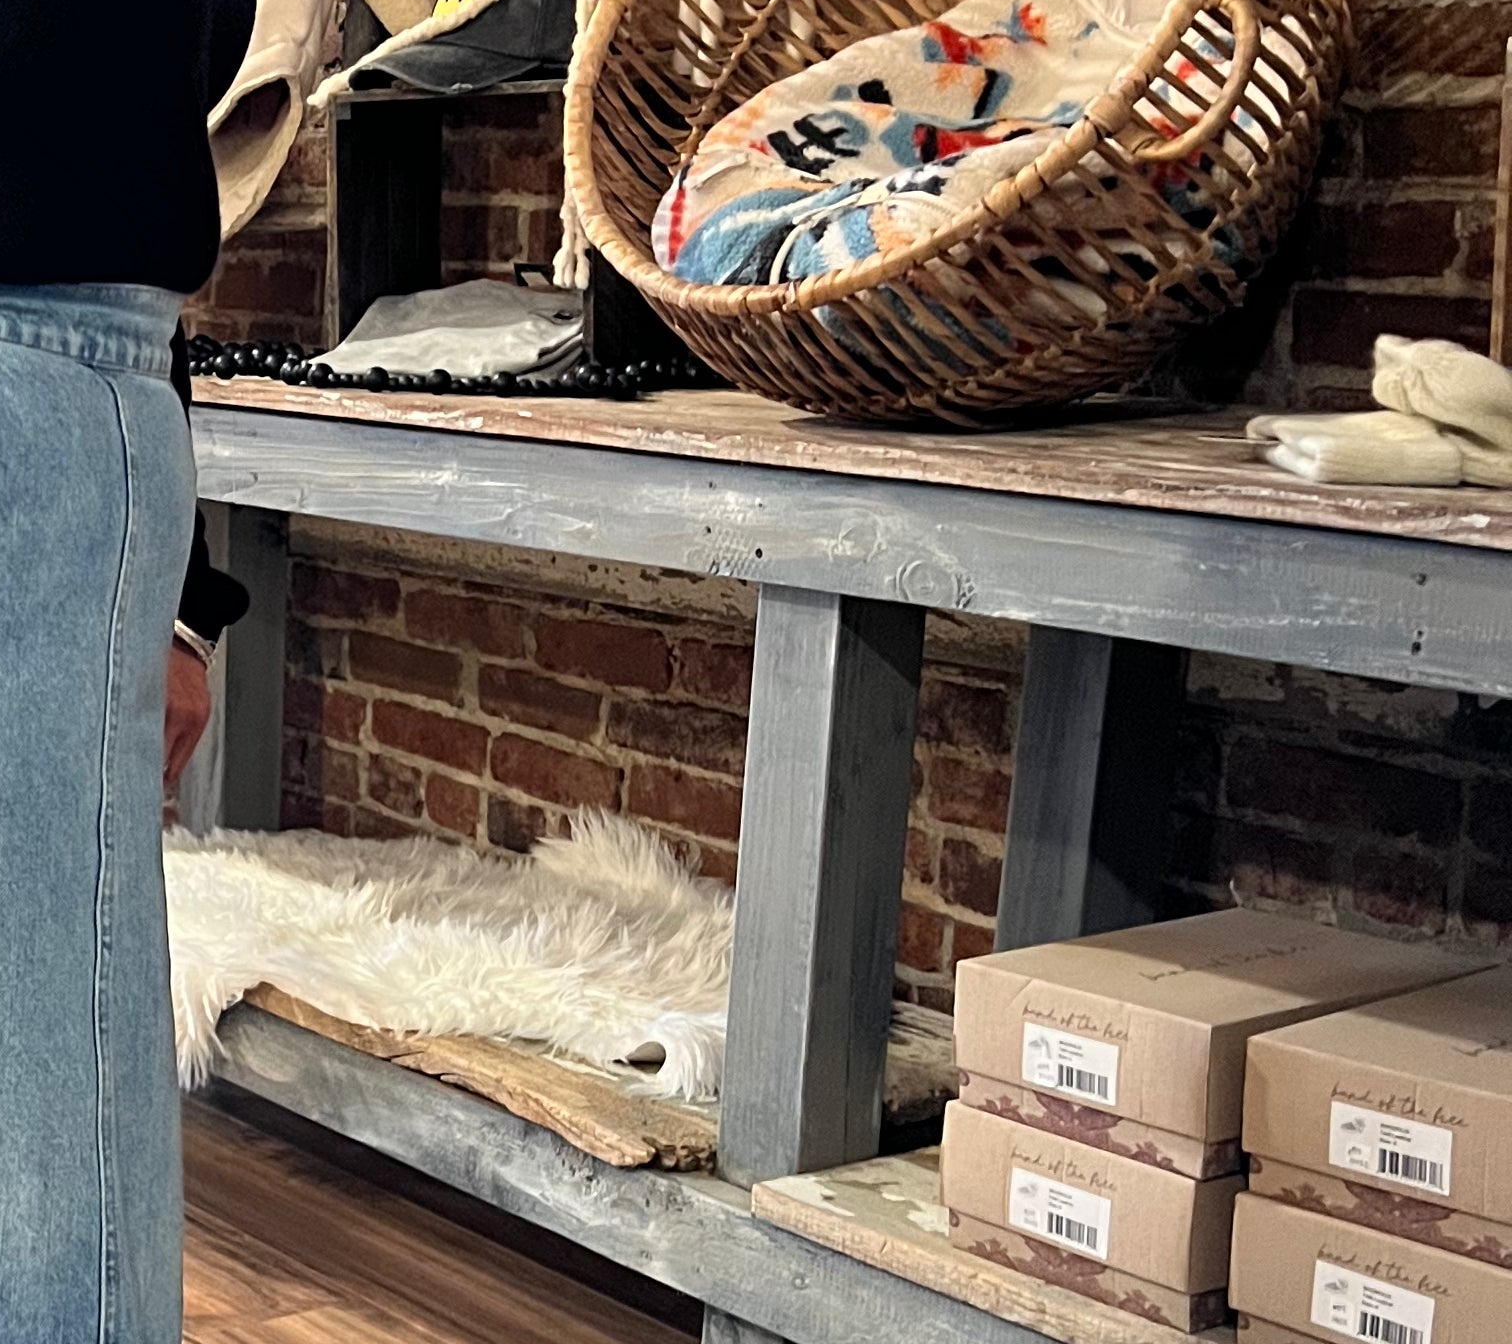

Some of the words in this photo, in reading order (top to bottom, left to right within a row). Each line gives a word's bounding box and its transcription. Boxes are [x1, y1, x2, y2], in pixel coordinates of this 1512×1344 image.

[1075, 1013, 1099, 1032] the
[1397, 1096, 1427, 1117] the
[1065, 1160, 1086, 1181] the
[1383, 1261, 1411, 1282] the
